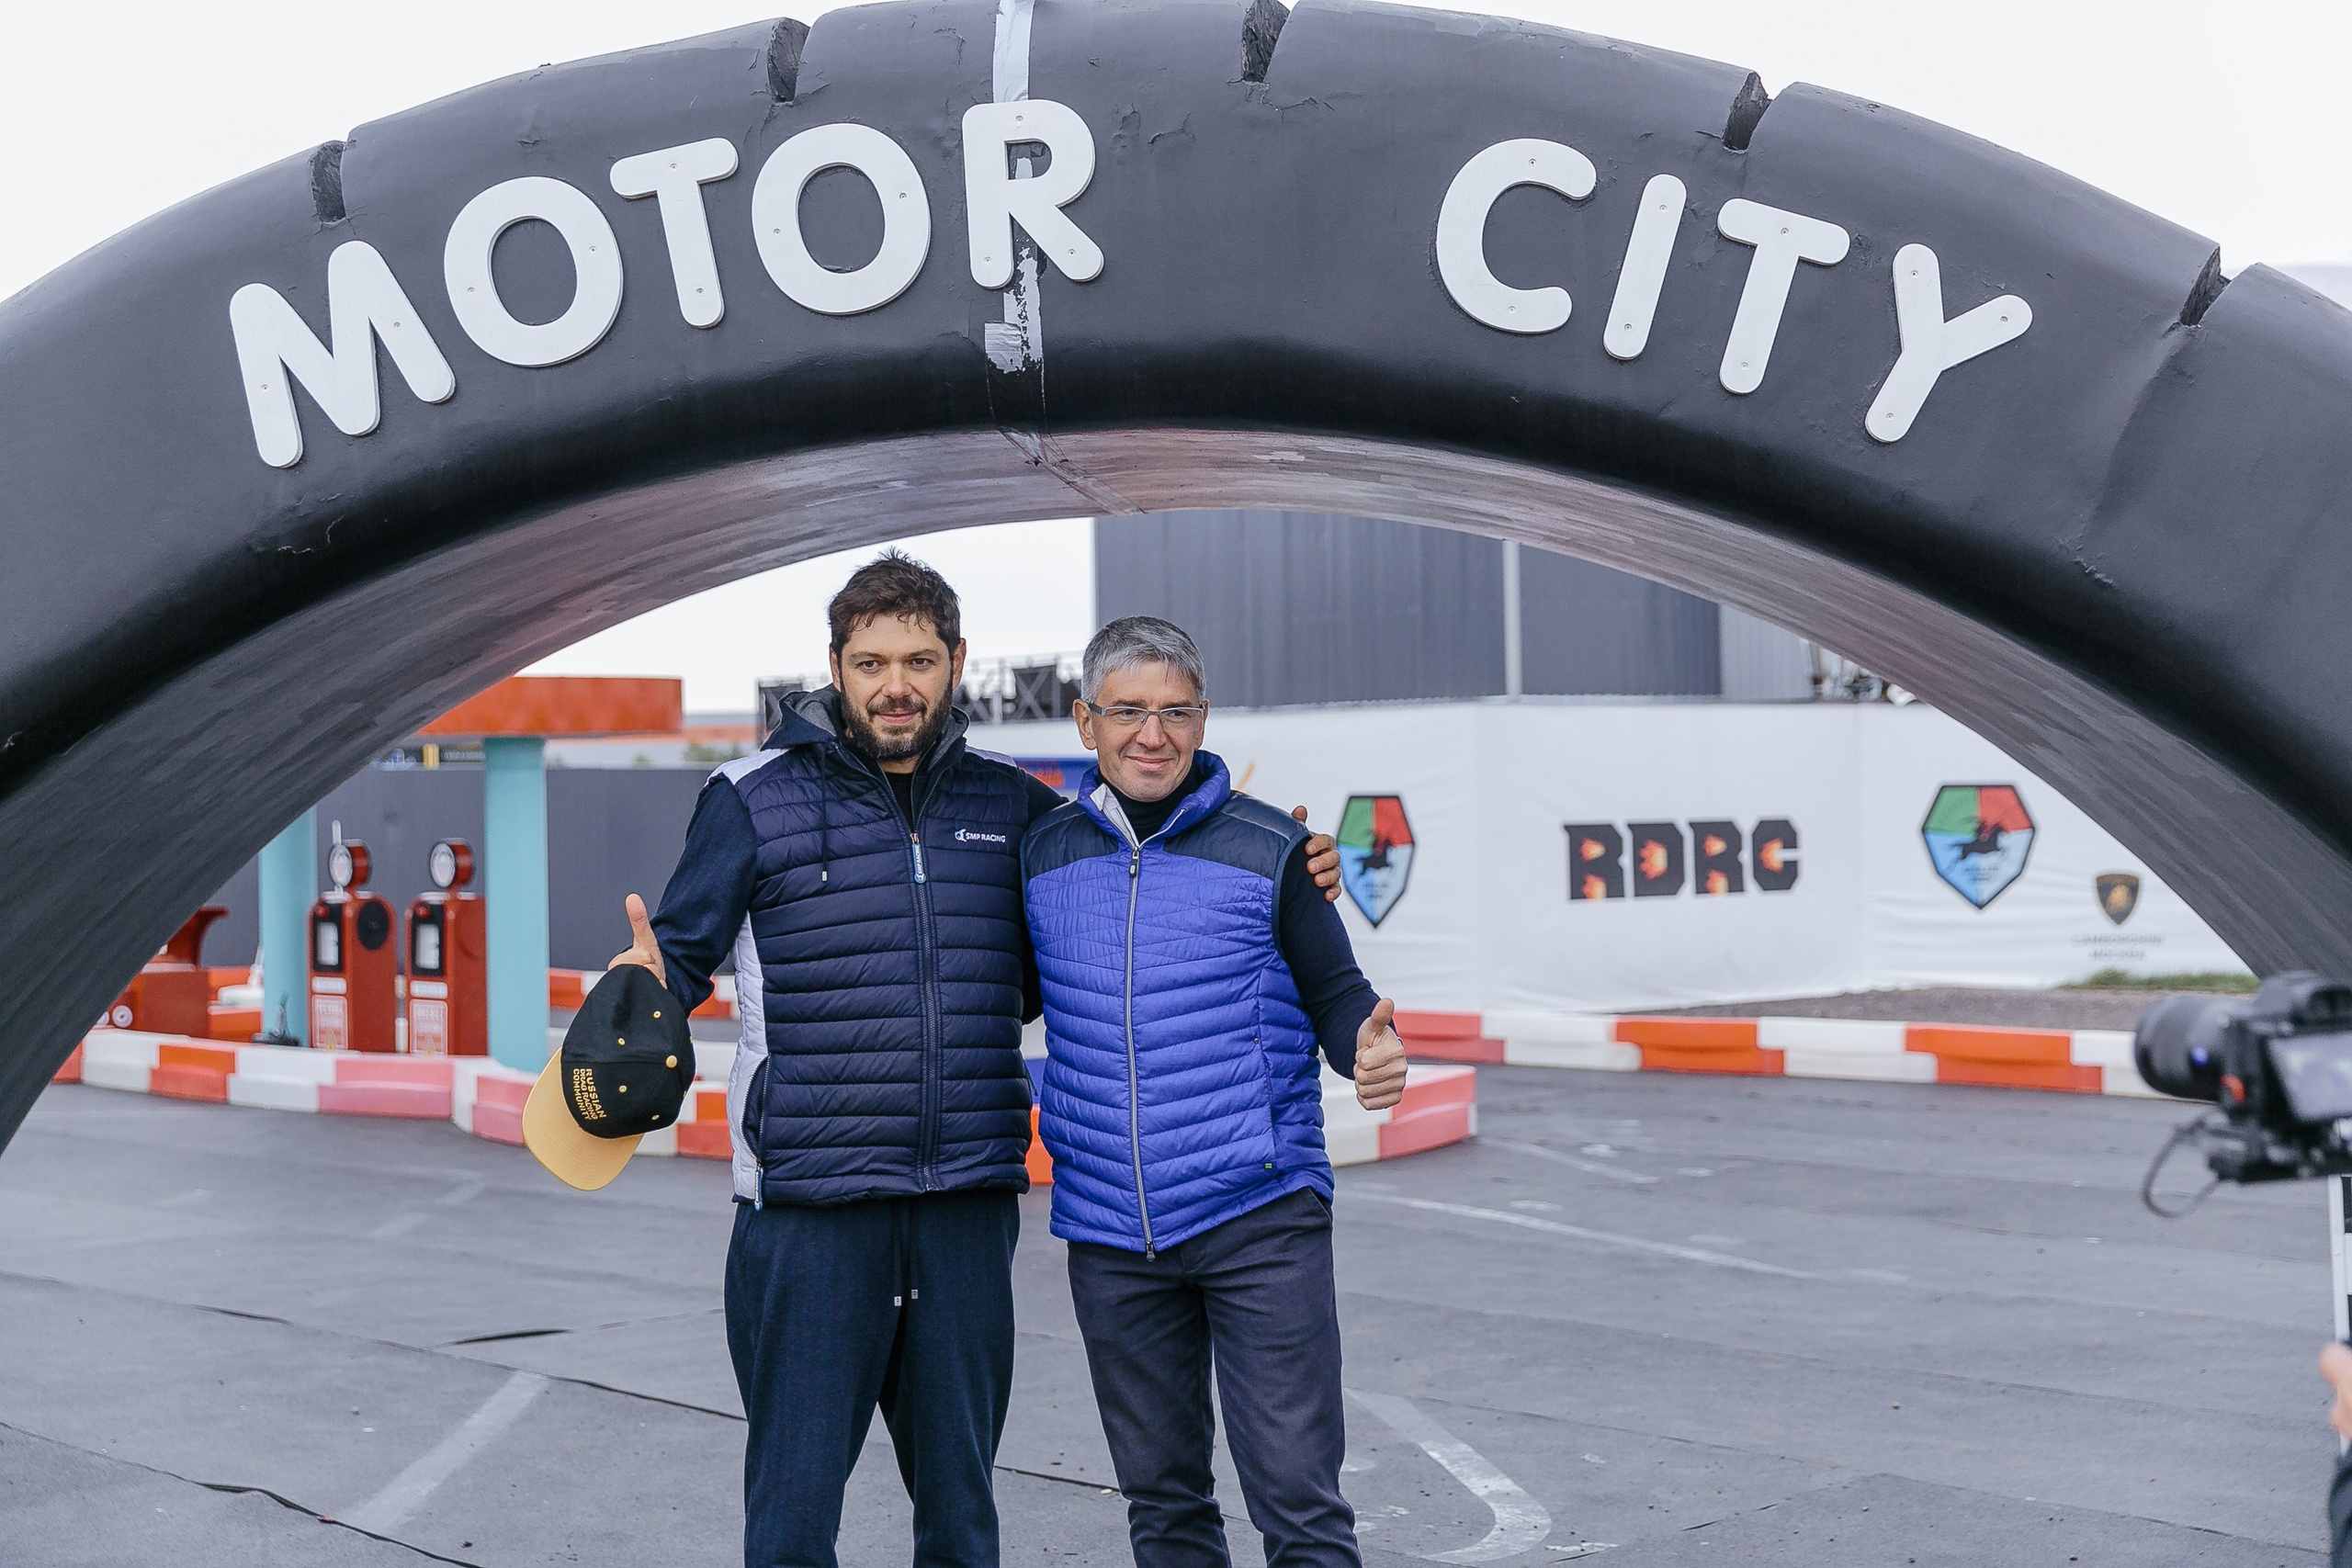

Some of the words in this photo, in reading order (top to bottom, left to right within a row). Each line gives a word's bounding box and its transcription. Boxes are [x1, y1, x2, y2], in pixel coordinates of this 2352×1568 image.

[230, 99, 1104, 468] MOTOR
[1435, 138, 2033, 443] CITY
[966, 832, 980, 840] SMP
[981, 833, 1006, 843] RACING
[1564, 819, 1798, 900] RDRC
[572, 1068, 592, 1120] COMMUNITY
[582, 1092, 598, 1120] RACING
[586, 1068, 606, 1118] RUSSIAN
